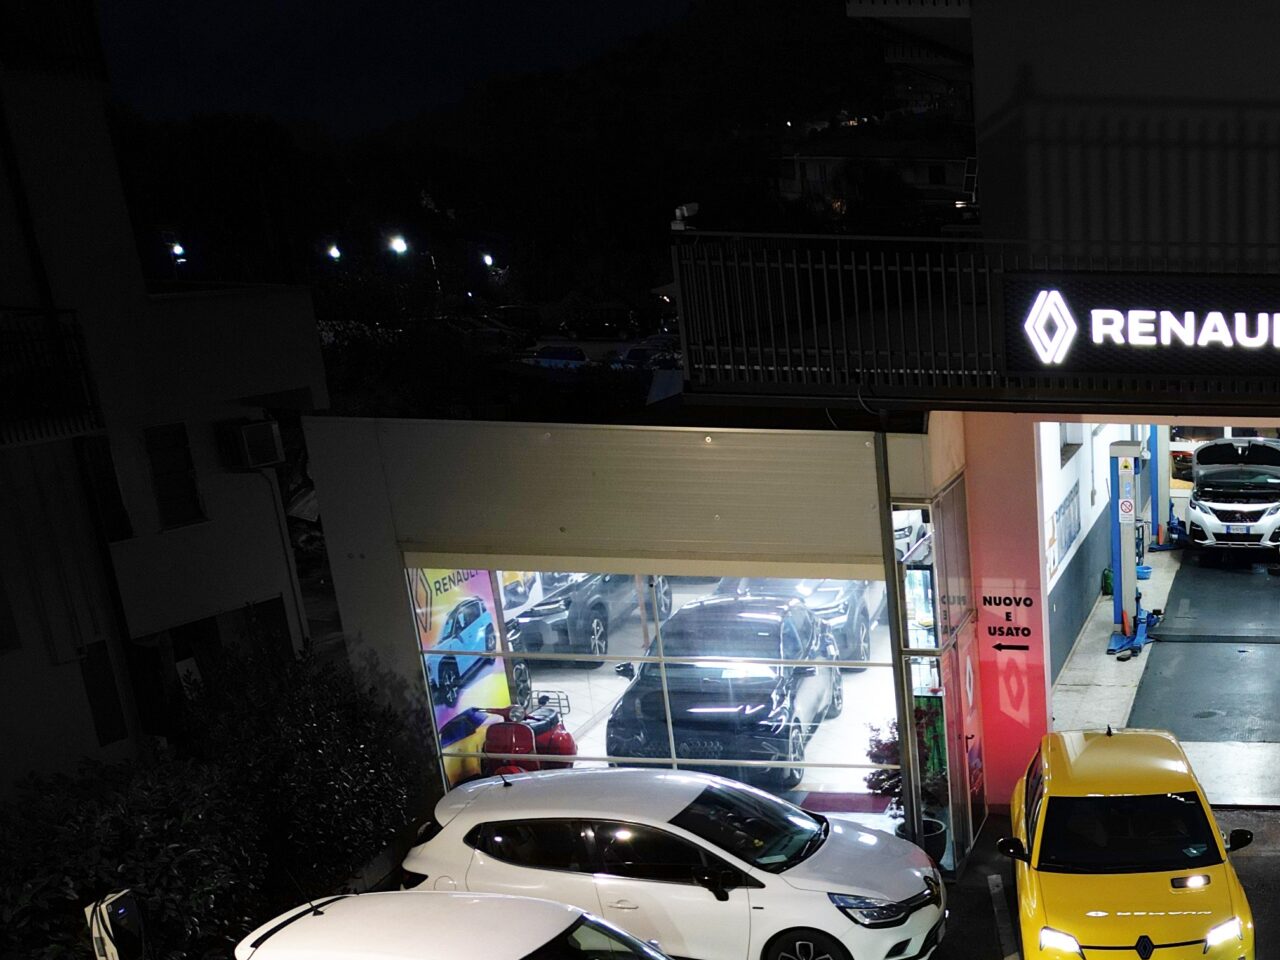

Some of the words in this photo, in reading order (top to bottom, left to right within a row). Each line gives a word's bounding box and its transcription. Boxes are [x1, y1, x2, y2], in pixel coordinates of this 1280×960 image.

[982, 596, 1033, 607] NUOVO
[1005, 611, 1012, 621] E
[988, 626, 1032, 637] USATO
